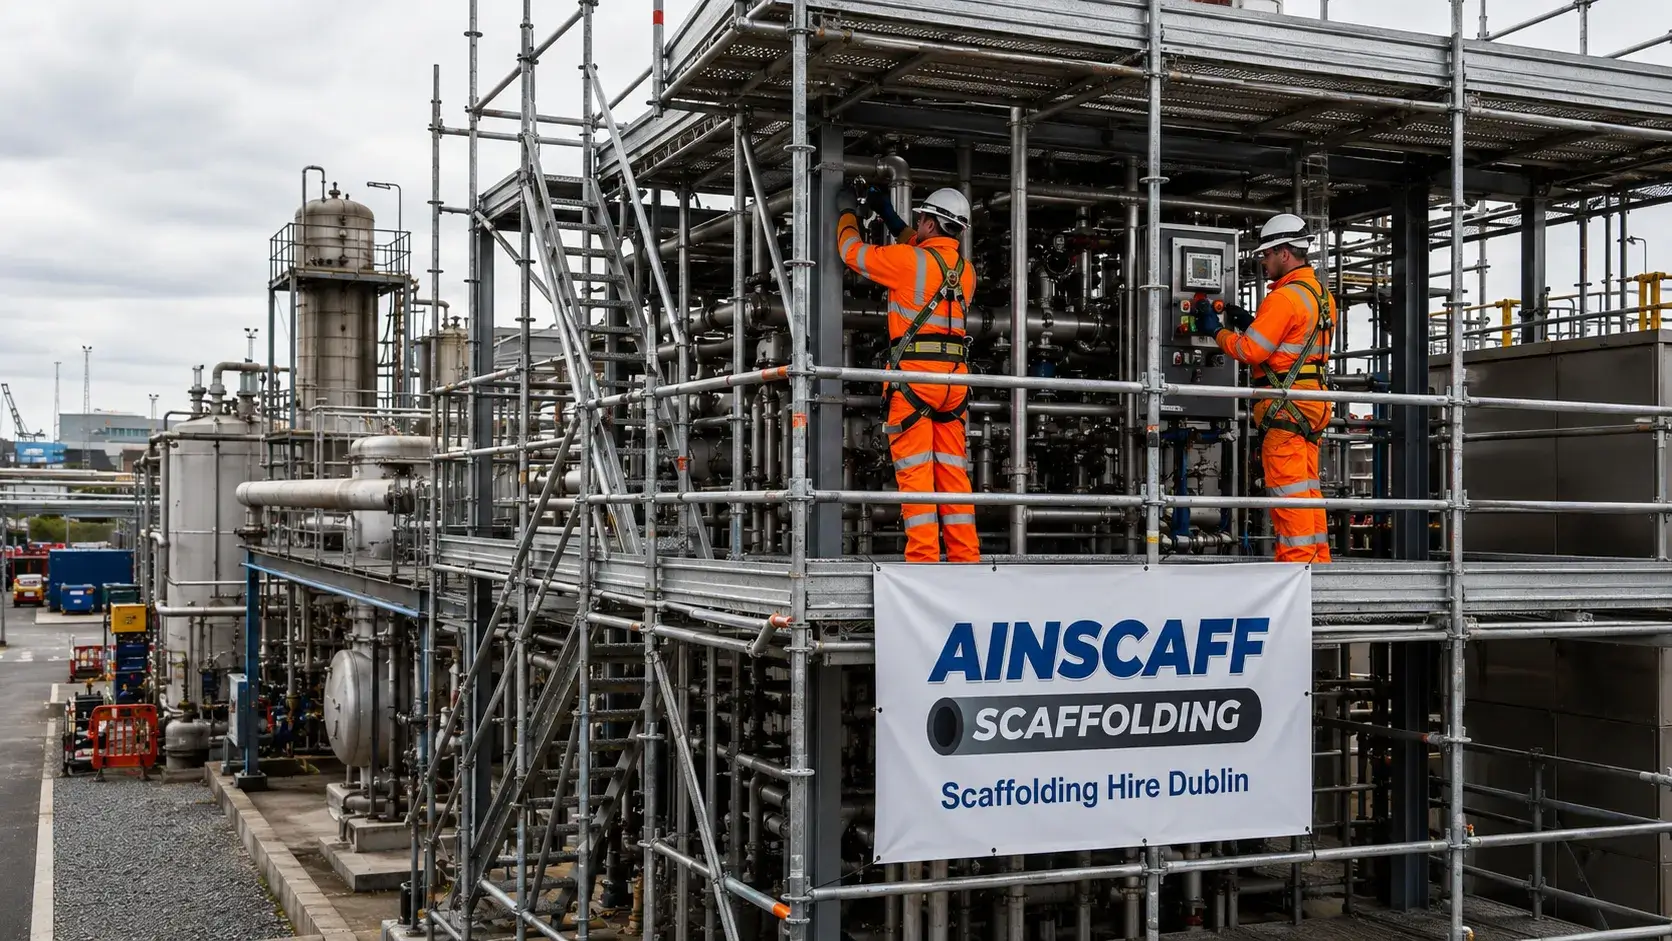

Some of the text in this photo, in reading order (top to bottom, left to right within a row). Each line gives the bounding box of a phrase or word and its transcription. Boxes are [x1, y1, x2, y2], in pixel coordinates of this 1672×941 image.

[927, 616, 1271, 683] AINSCAFF
[972, 699, 1242, 742] SCAFFOLDING
[941, 767, 1249, 810] Scaffolding Hire Dublin
